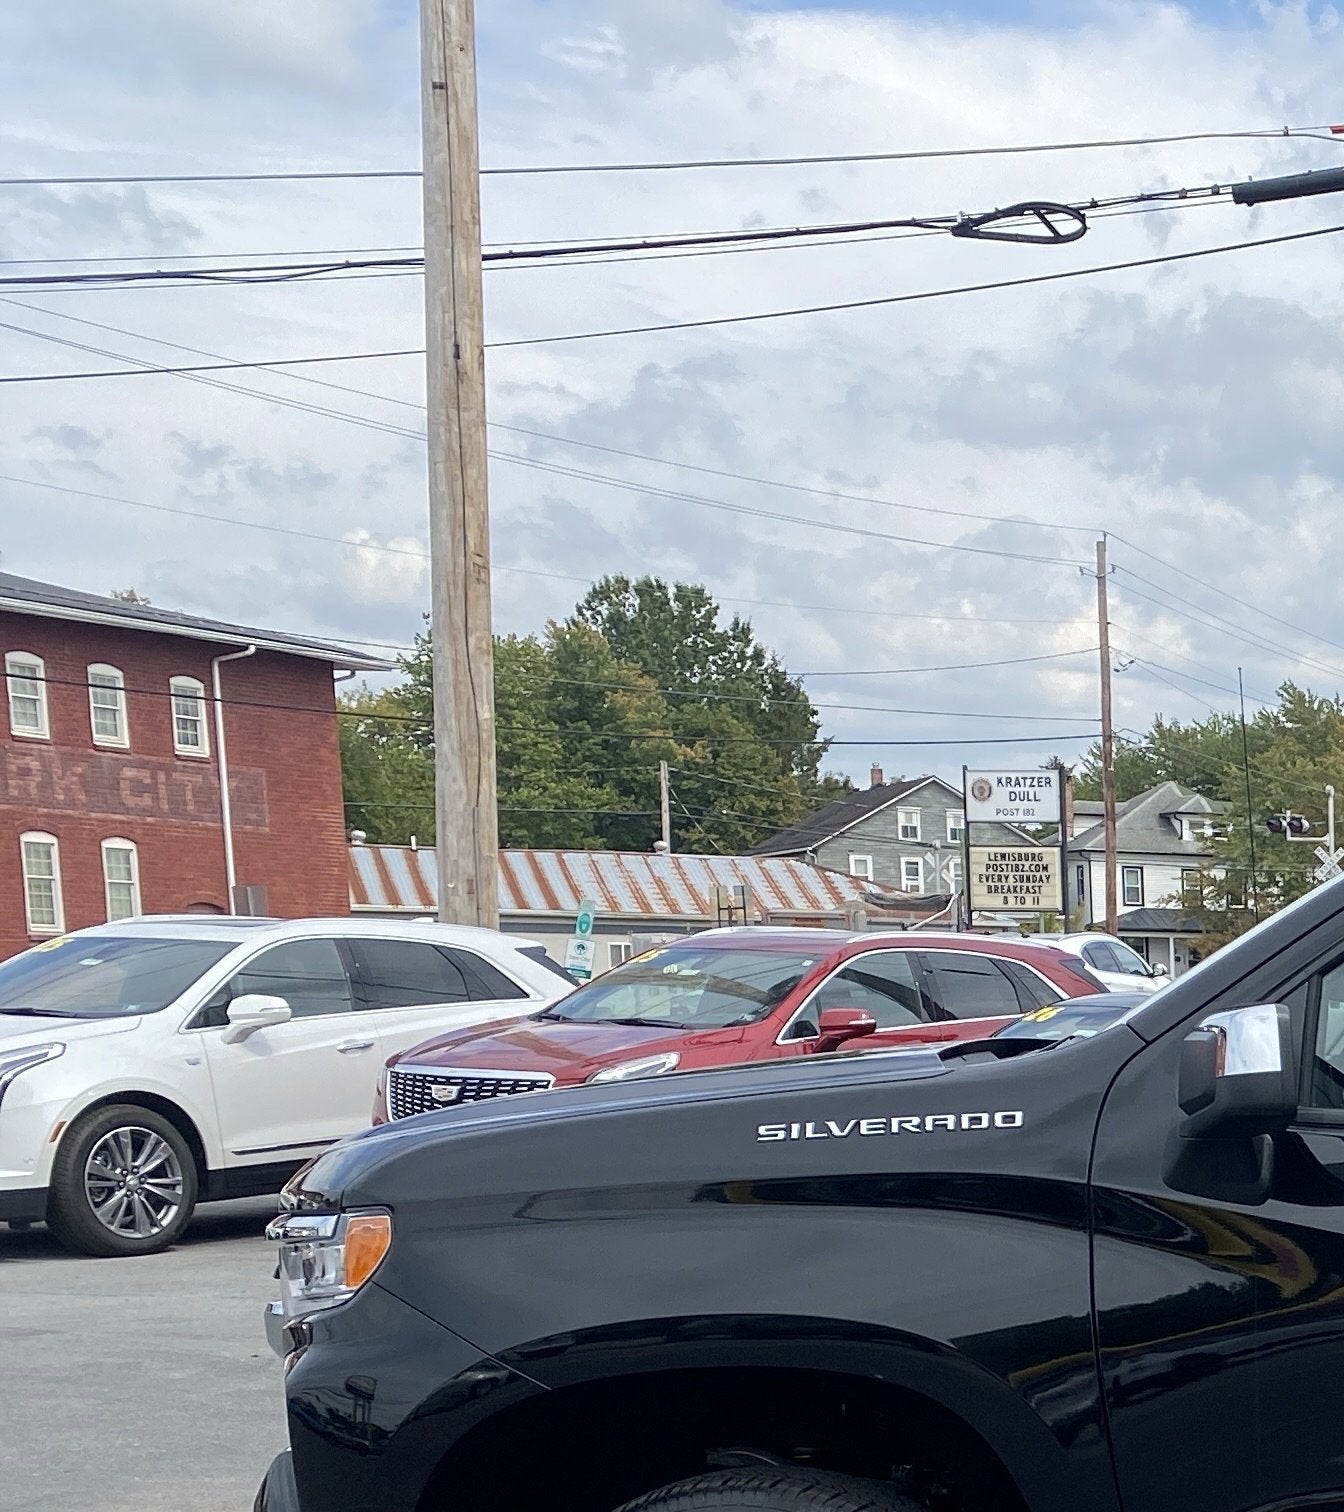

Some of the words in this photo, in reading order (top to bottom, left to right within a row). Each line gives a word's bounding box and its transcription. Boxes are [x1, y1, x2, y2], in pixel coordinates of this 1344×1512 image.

[996, 776, 1053, 788] KRATZER
[1008, 790, 1041, 802] DULL
[995, 808, 1020, 816] POST
[1022, 808, 1035, 816] 182
[987, 852, 1044, 862] LEWISBURG
[985, 863, 1049, 873] POST182.COM
[978, 873, 1010, 883] EVERY
[1012, 874, 1051, 884] SUNDAY
[986, 885, 1043, 894] BREAKFAST
[1002, 895, 1009, 905] 8
[1013, 896, 1026, 905] TO
[756, 1110, 1024, 1143] SILVERADO
